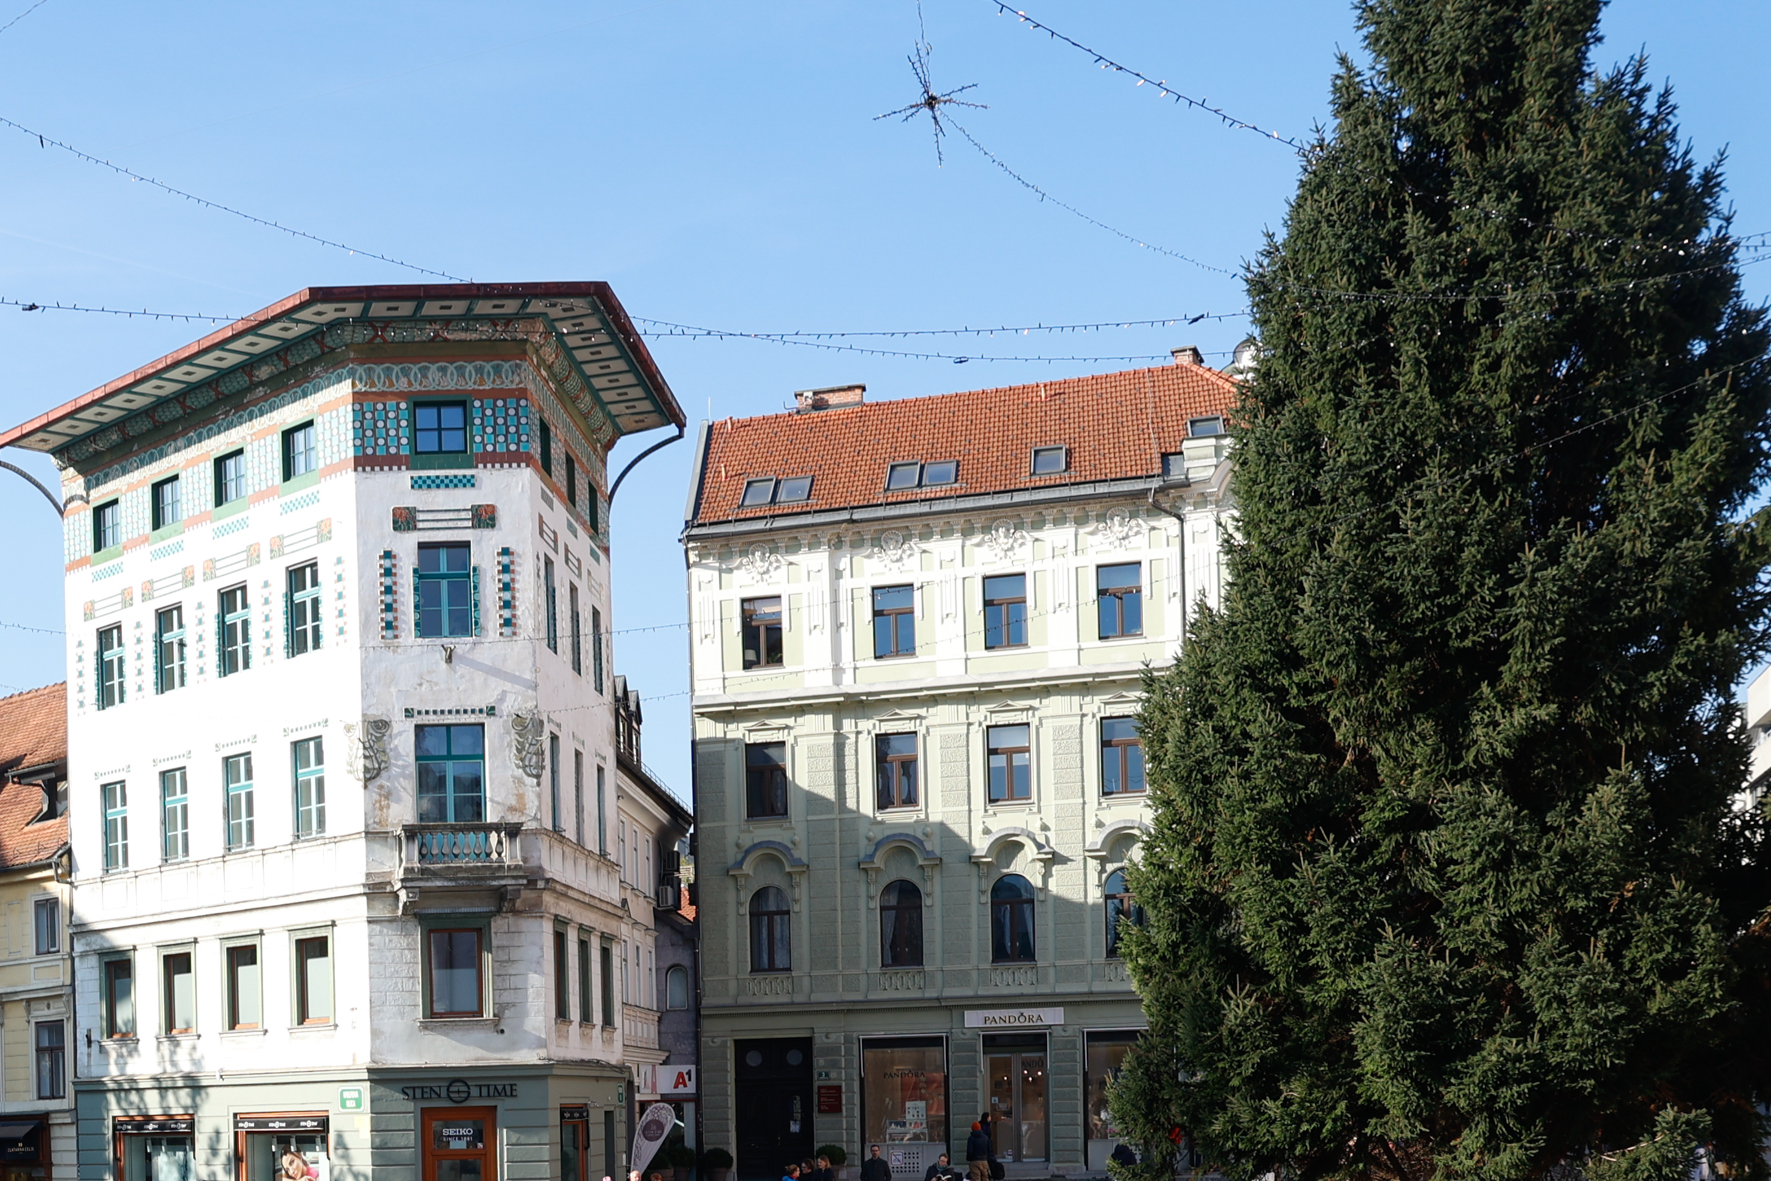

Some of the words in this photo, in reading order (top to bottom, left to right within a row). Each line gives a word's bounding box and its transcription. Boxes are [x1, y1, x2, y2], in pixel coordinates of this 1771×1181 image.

[673, 1069, 692, 1089] A1
[401, 1085, 443, 1100] STEN
[475, 1083, 518, 1098] TIME
[442, 1128, 473, 1136] SEIKO
